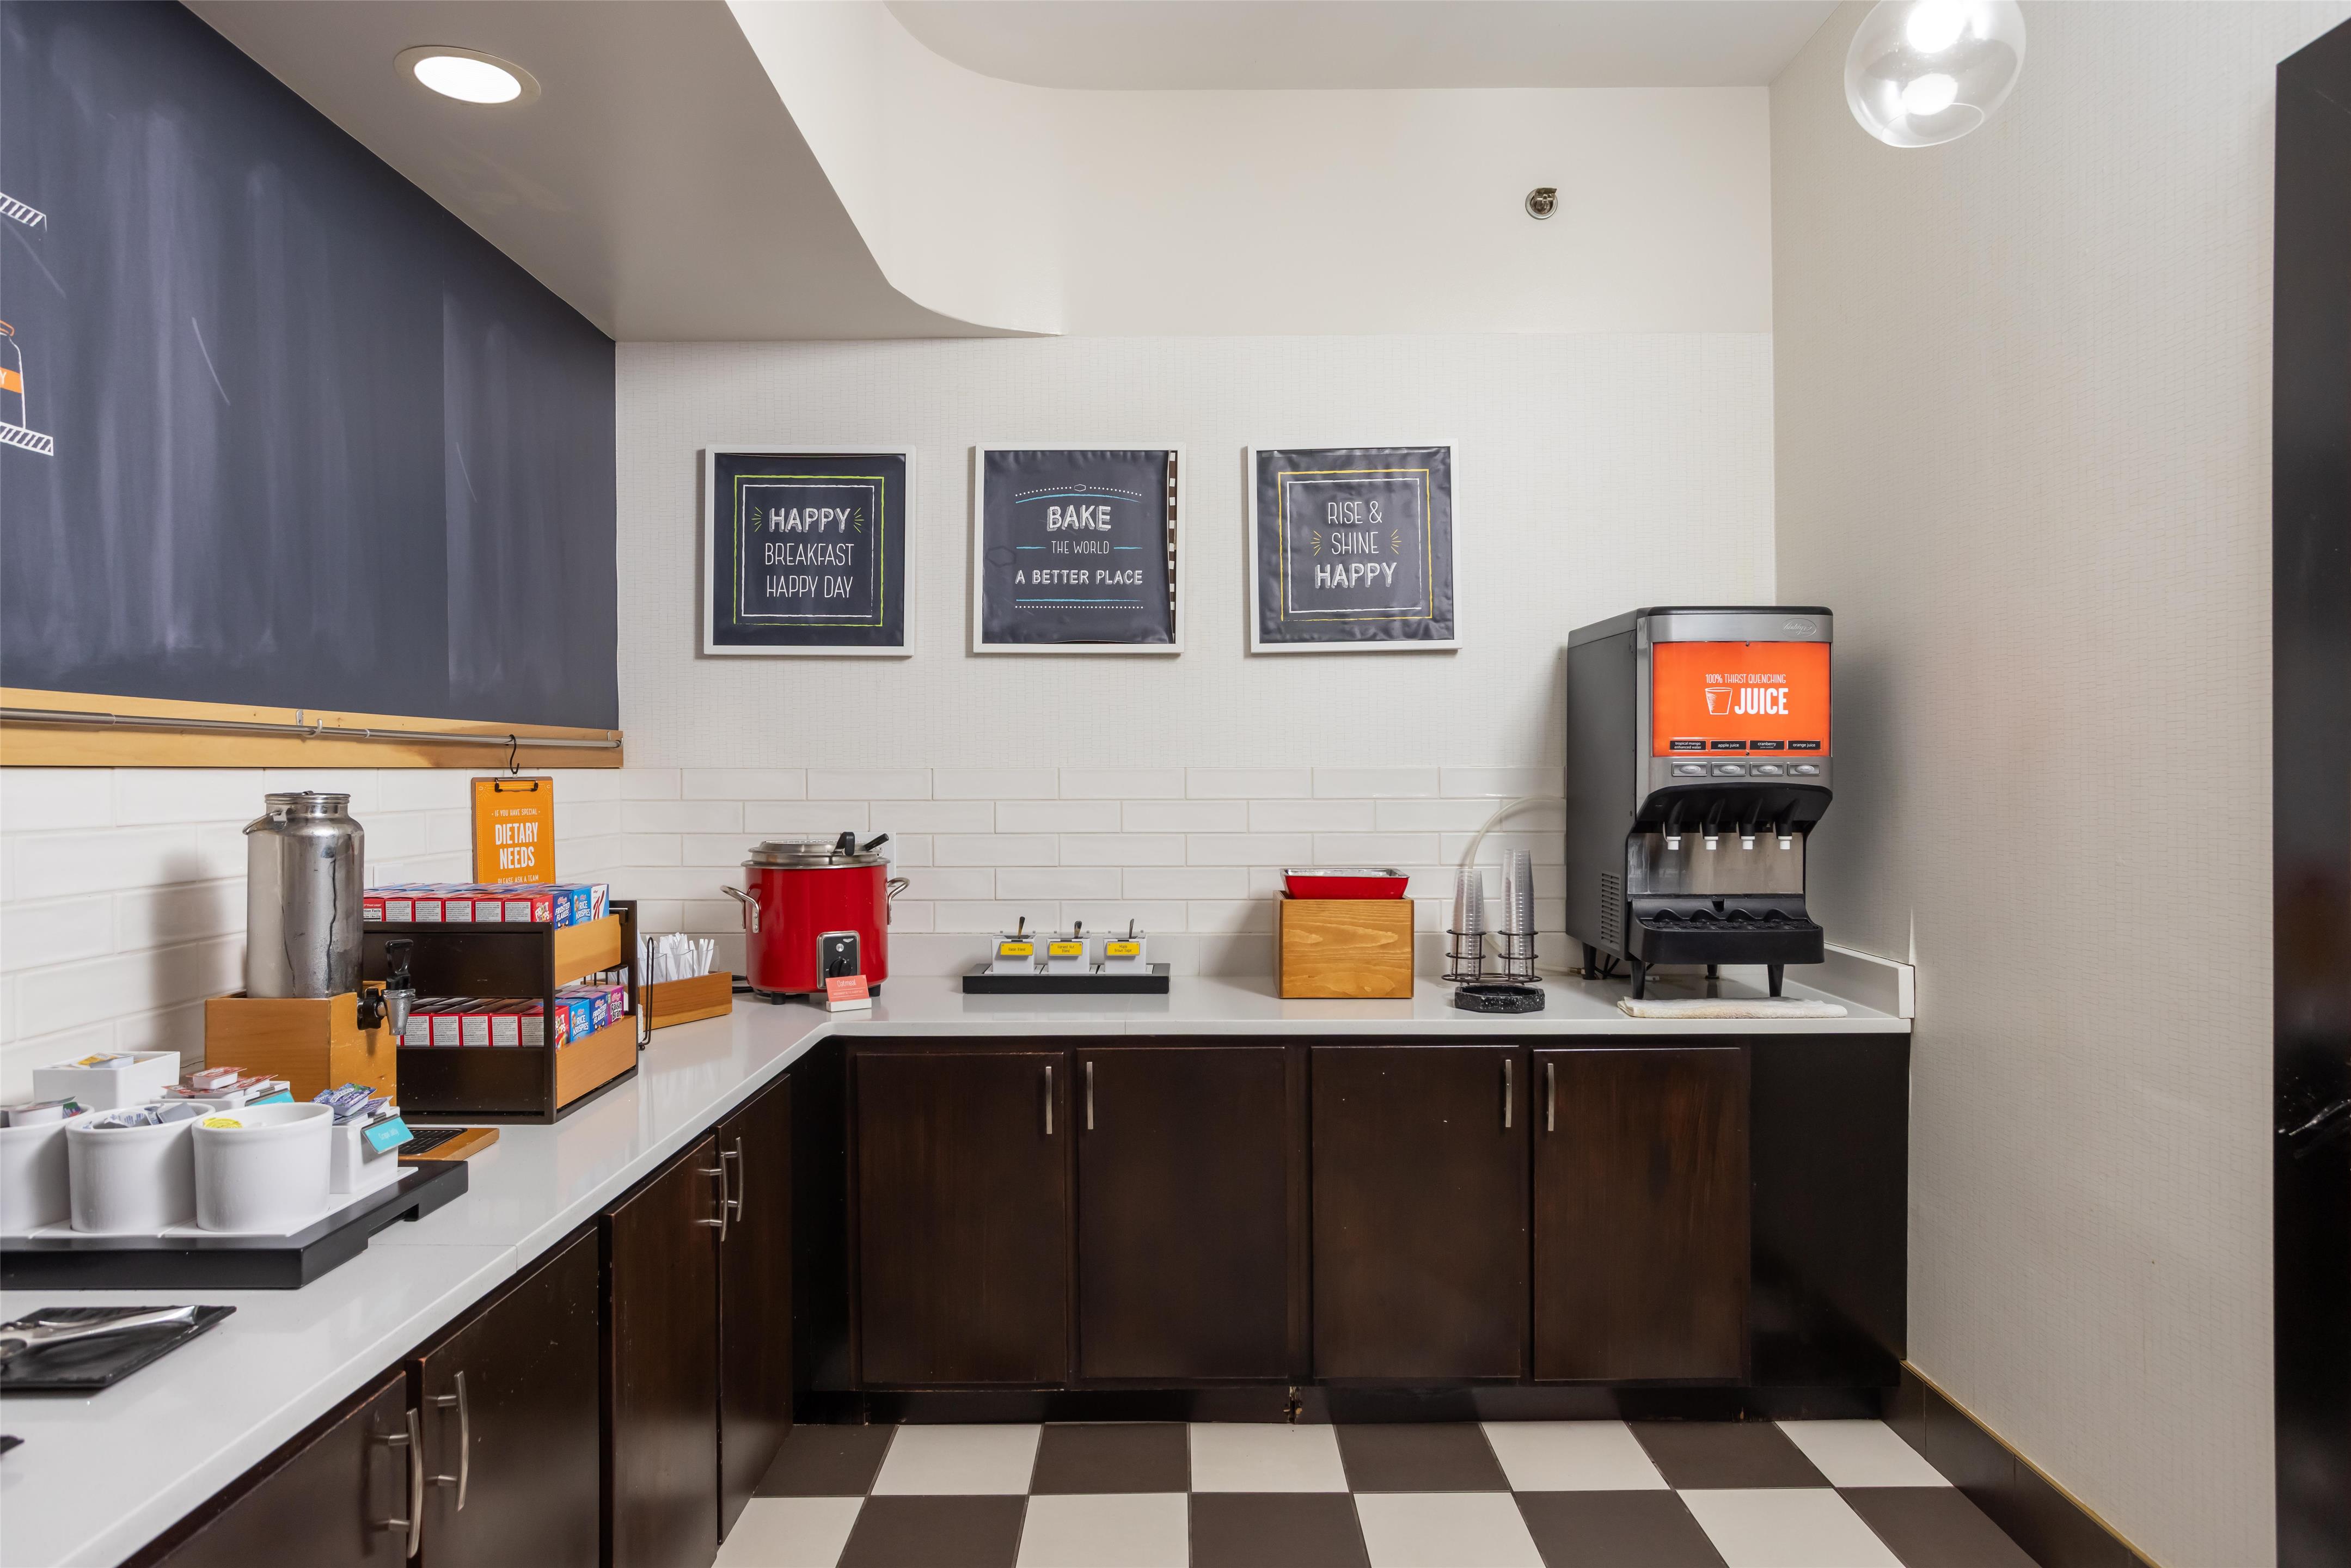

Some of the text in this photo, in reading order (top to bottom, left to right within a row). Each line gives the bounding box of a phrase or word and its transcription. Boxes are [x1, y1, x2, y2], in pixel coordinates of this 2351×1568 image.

[769, 507, 850, 533] HAPPY
[1046, 505, 1111, 531] BAKE
[1328, 500, 1382, 524] RISE &
[1051, 541, 1109, 554] THE WORLD
[1331, 531, 1379, 555] SHINE
[765, 543, 854, 566] BREAKFAST
[1015, 569, 1143, 585] A BETTER PLACE
[1314, 562, 1397, 589] HAPPY
[767, 575, 853, 598] HAPPY DAY
[1705, 673, 1786, 684] 100% THIRST QUENCHING
[1734, 688, 1789, 714] JUICE
[495, 822, 538, 845] DIETARY
[499, 846, 535, 869] NEEDS
[535, 902, 549, 919] FROOT
[555, 902, 570, 915] FROSTED
[579, 901, 587, 910] RICE
[556, 910, 570, 922] FLAKES
[576, 909, 591, 920] KRISPIES
[592, 1003, 607, 1019] FROSTED
[610, 1001, 622, 1014] Raisin
[611, 1009, 622, 1022] Bran
[577, 1014, 585, 1025] RICE
[593, 1011, 605, 1025] FLAKES
[573, 1022, 589, 1036] KRISPIES
